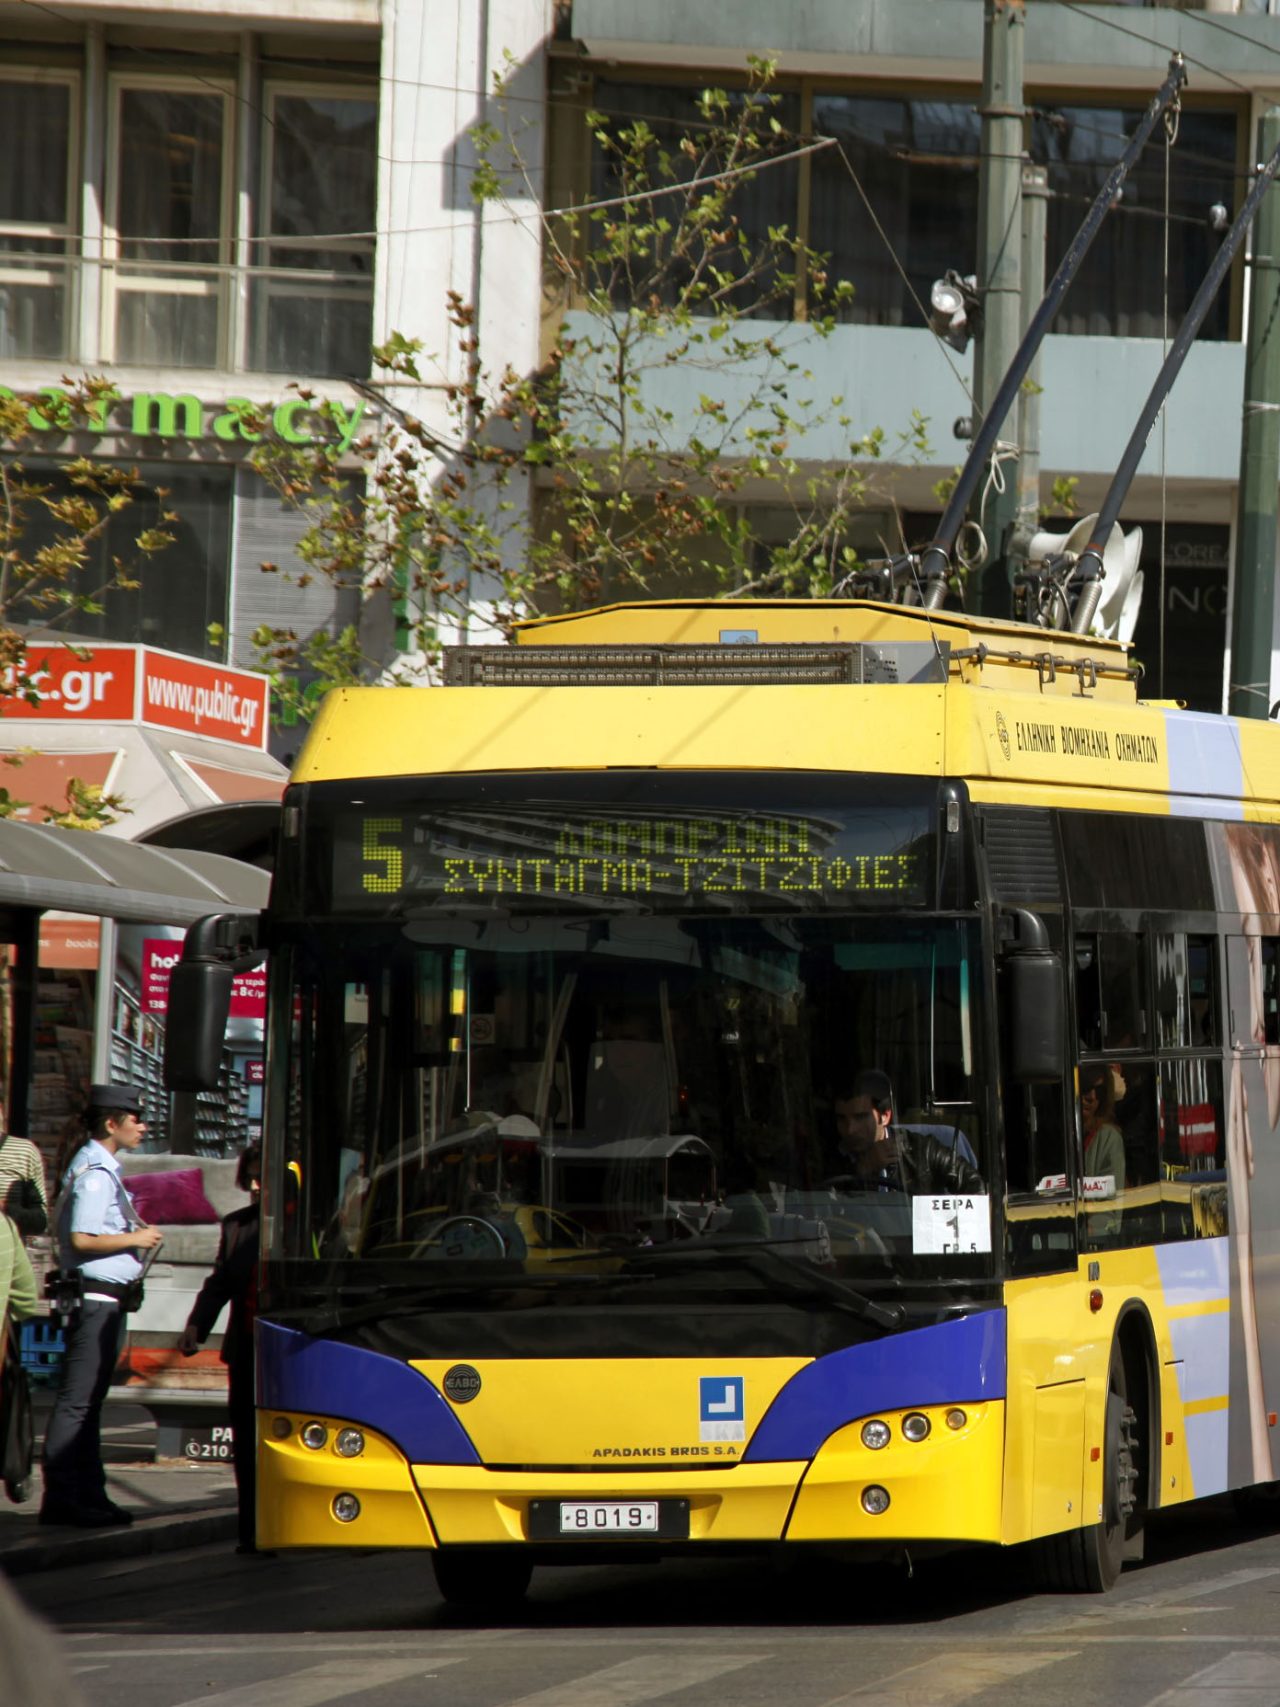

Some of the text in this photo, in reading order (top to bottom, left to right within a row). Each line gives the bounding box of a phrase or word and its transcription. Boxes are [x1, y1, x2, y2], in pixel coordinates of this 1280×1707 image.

[0, 386, 367, 453] armacy
[147, 674, 259, 737] www.public.gr
[362, 818, 402, 893] 5
[946, 1215, 960, 1239] 1
[592, 1447, 667, 1457] APADAKIS
[670, 1446, 710, 1456] BROS
[575, 1507, 643, 1529] 8019
